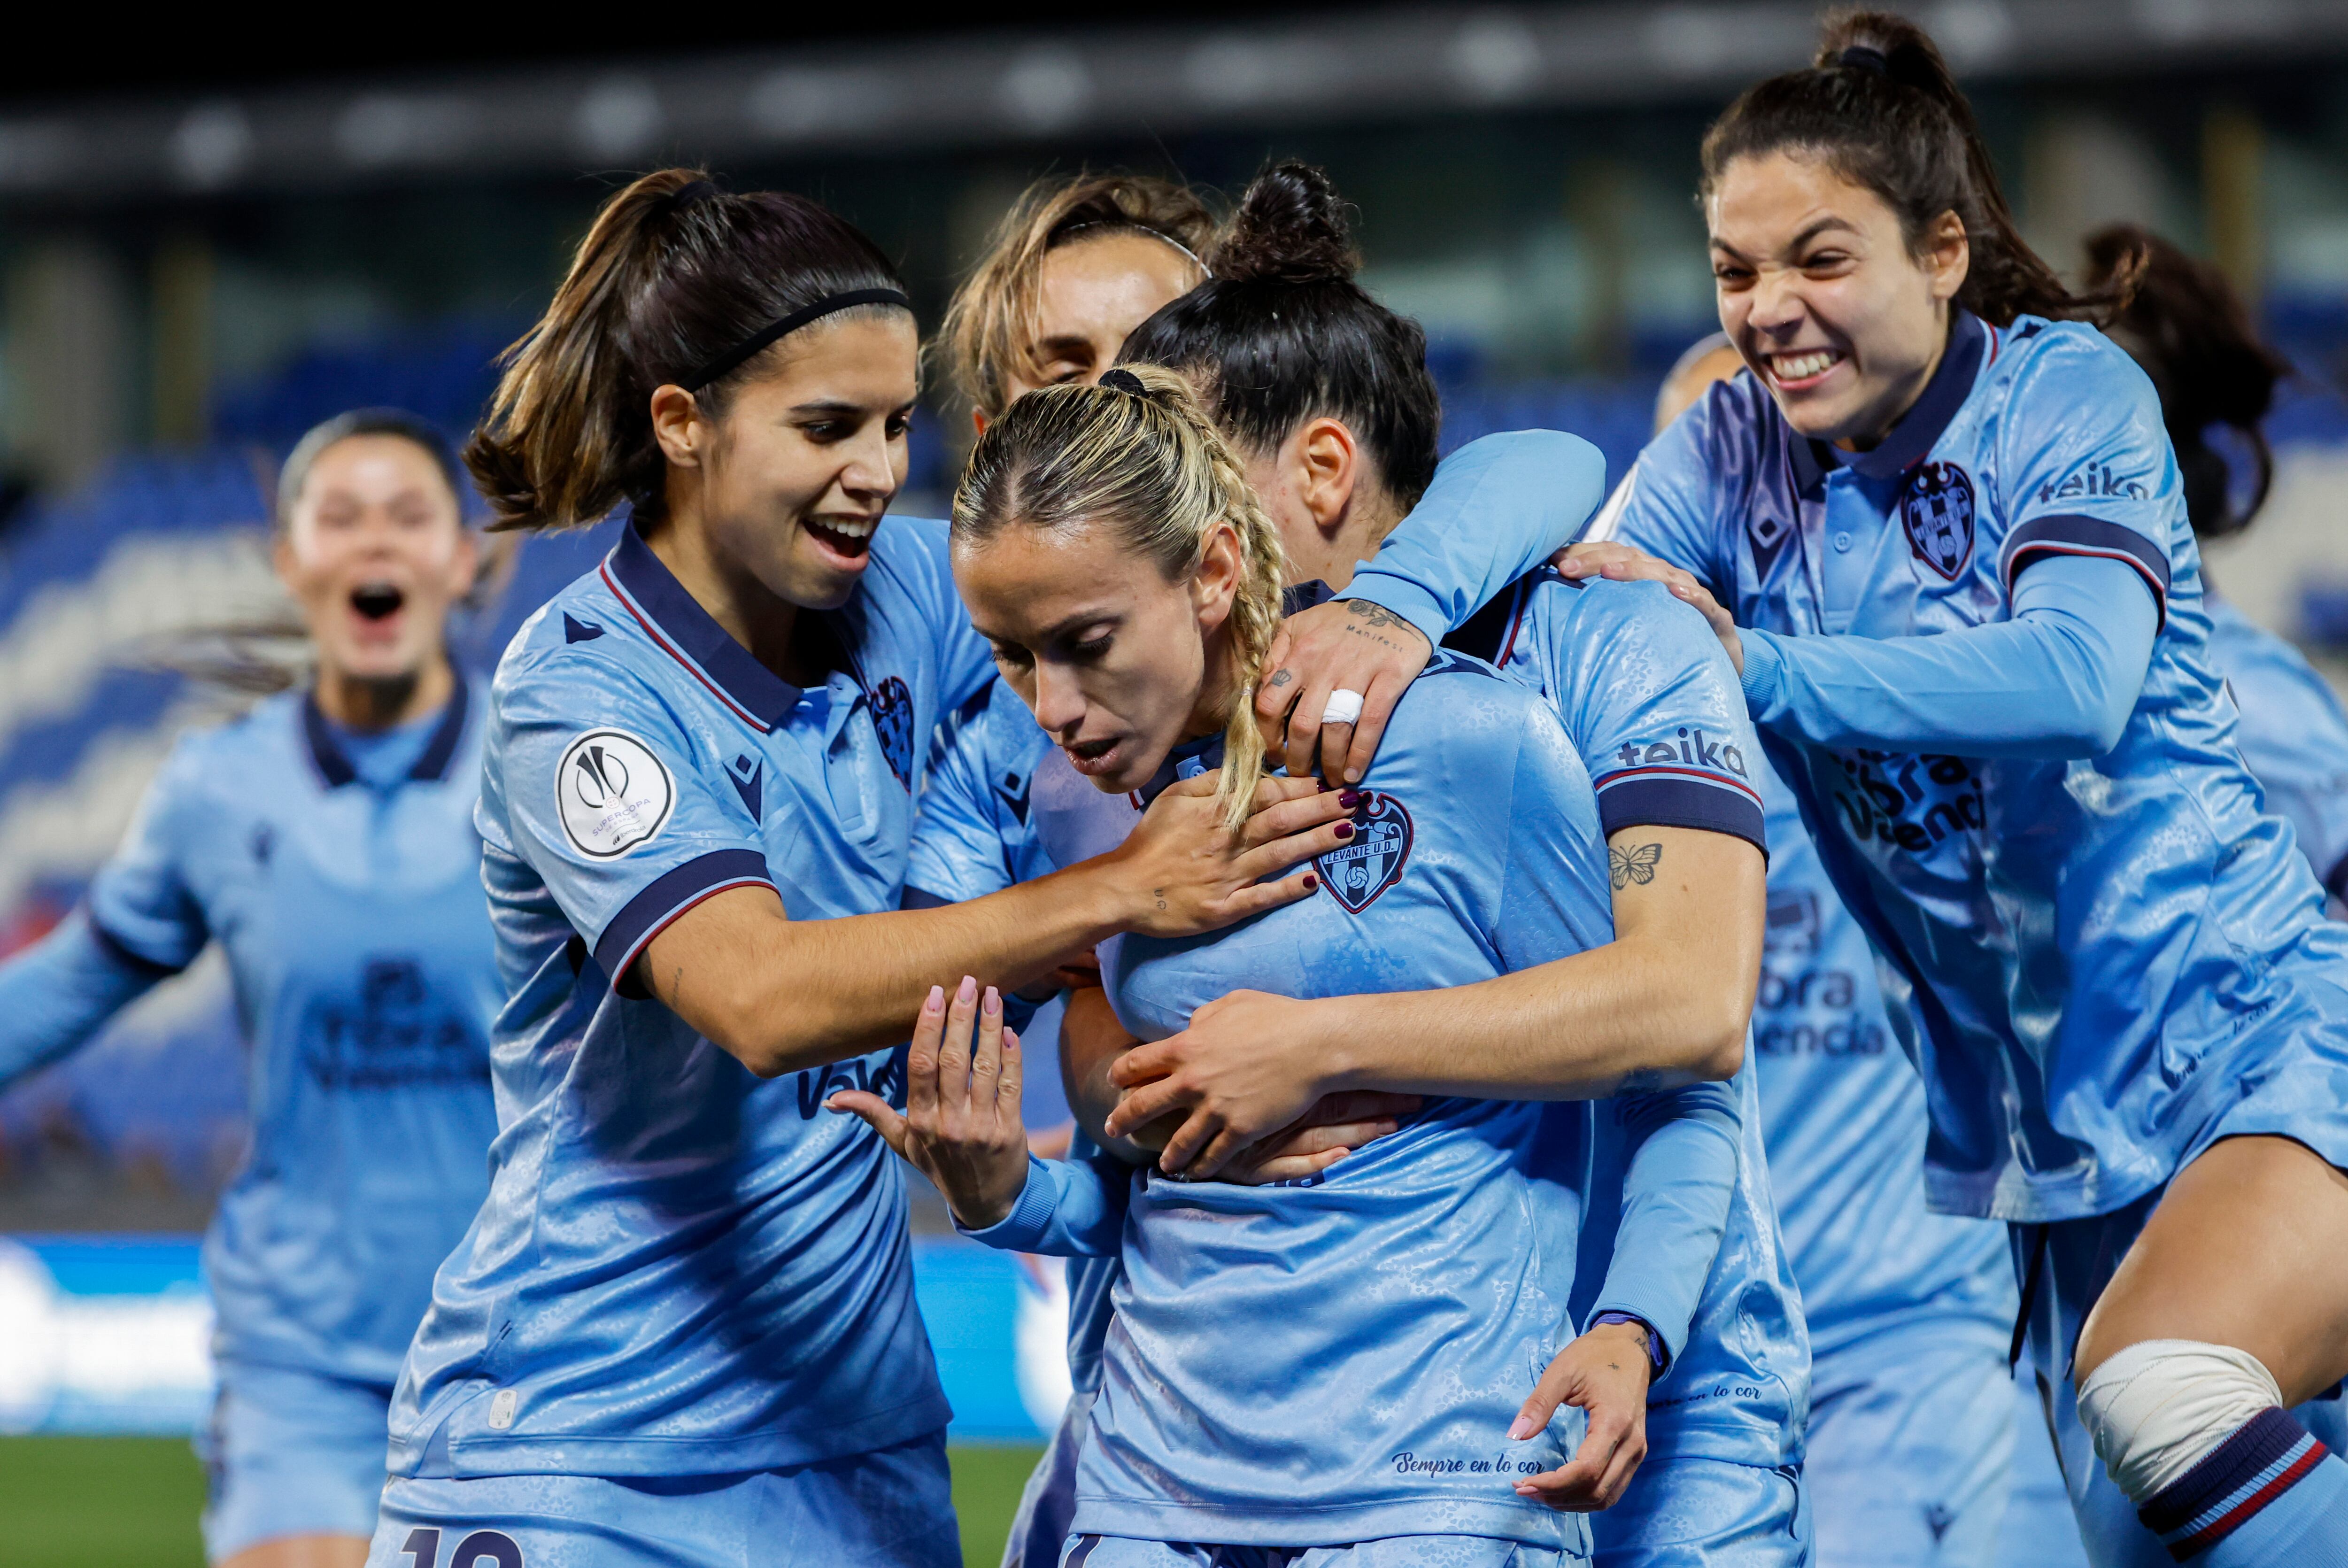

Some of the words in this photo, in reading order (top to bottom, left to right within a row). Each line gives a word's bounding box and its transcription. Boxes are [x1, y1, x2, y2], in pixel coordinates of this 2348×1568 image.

[2038, 462, 2149, 504] teika
[1346, 625, 1403, 653] Manifest
[1617, 727, 1748, 780] teika
[1828, 751, 1970, 817] ibra
[592, 798, 651, 836] SUPERCOPA
[1327, 845, 1371, 862] LEVANTE
[1374, 841, 1394, 853] U.D.
[1760, 964, 1855, 1011] bra
[1714, 1385, 1730, 1398] lo
[1735, 1386, 1762, 1400] cor
[1391, 1452, 1466, 1479] Sempre
[1470, 1460, 1492, 1473] en
[1496, 1453, 1513, 1473] lo
[1517, 1461, 1545, 1474] cor
